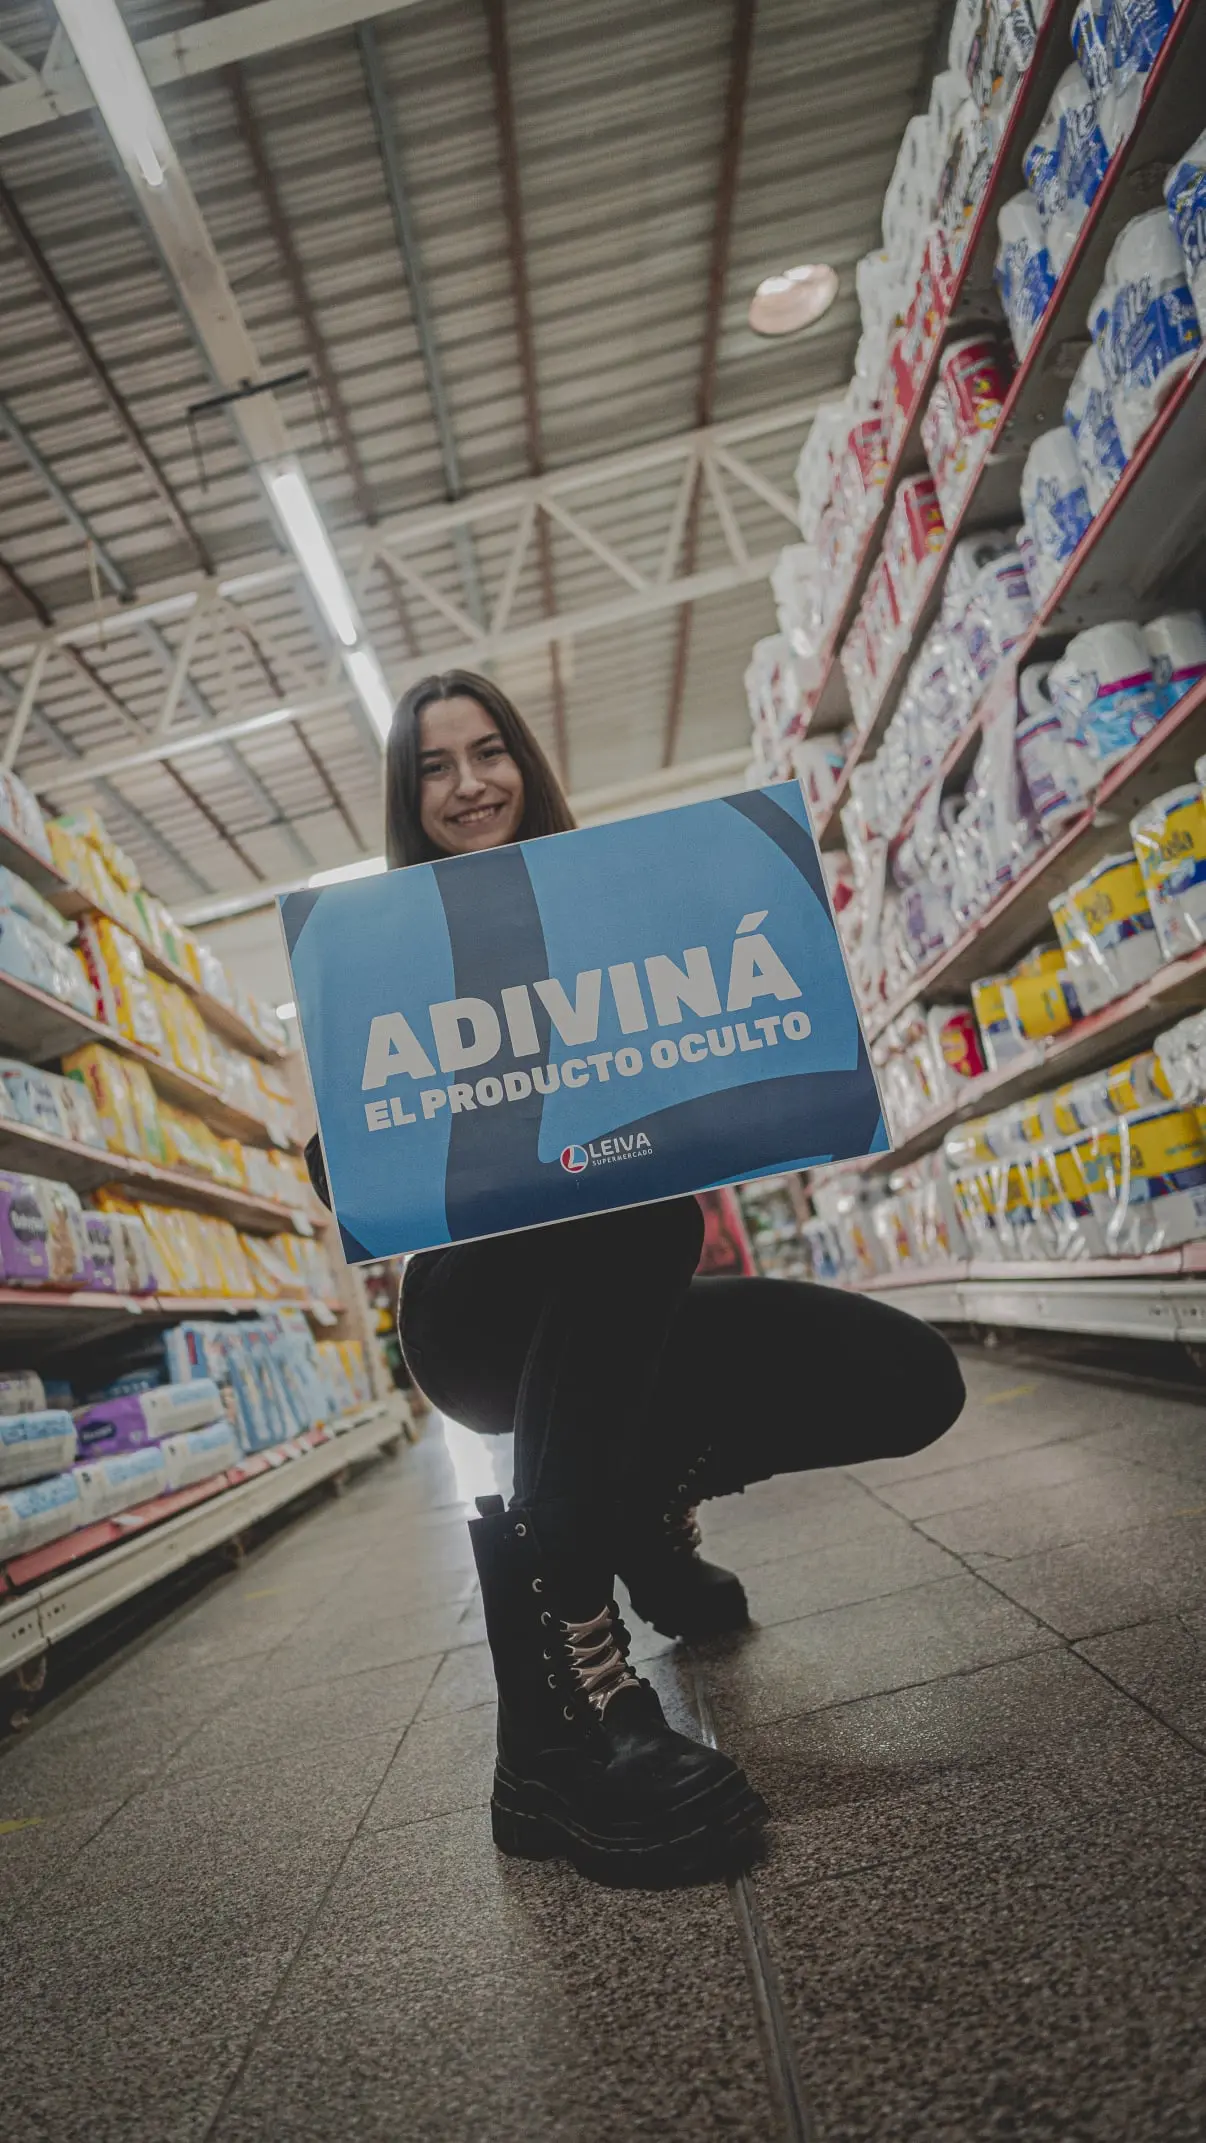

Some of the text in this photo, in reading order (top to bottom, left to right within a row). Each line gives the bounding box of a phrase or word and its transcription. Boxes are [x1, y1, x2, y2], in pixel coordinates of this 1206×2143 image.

[361, 910, 802, 1090] ADIVINÁ
[364, 1011, 811, 1131] EL PRODUCTO OCULTO
[588, 1132, 651, 1158] LEIVA
[592, 1148, 653, 1166] SUPERMERCADO
